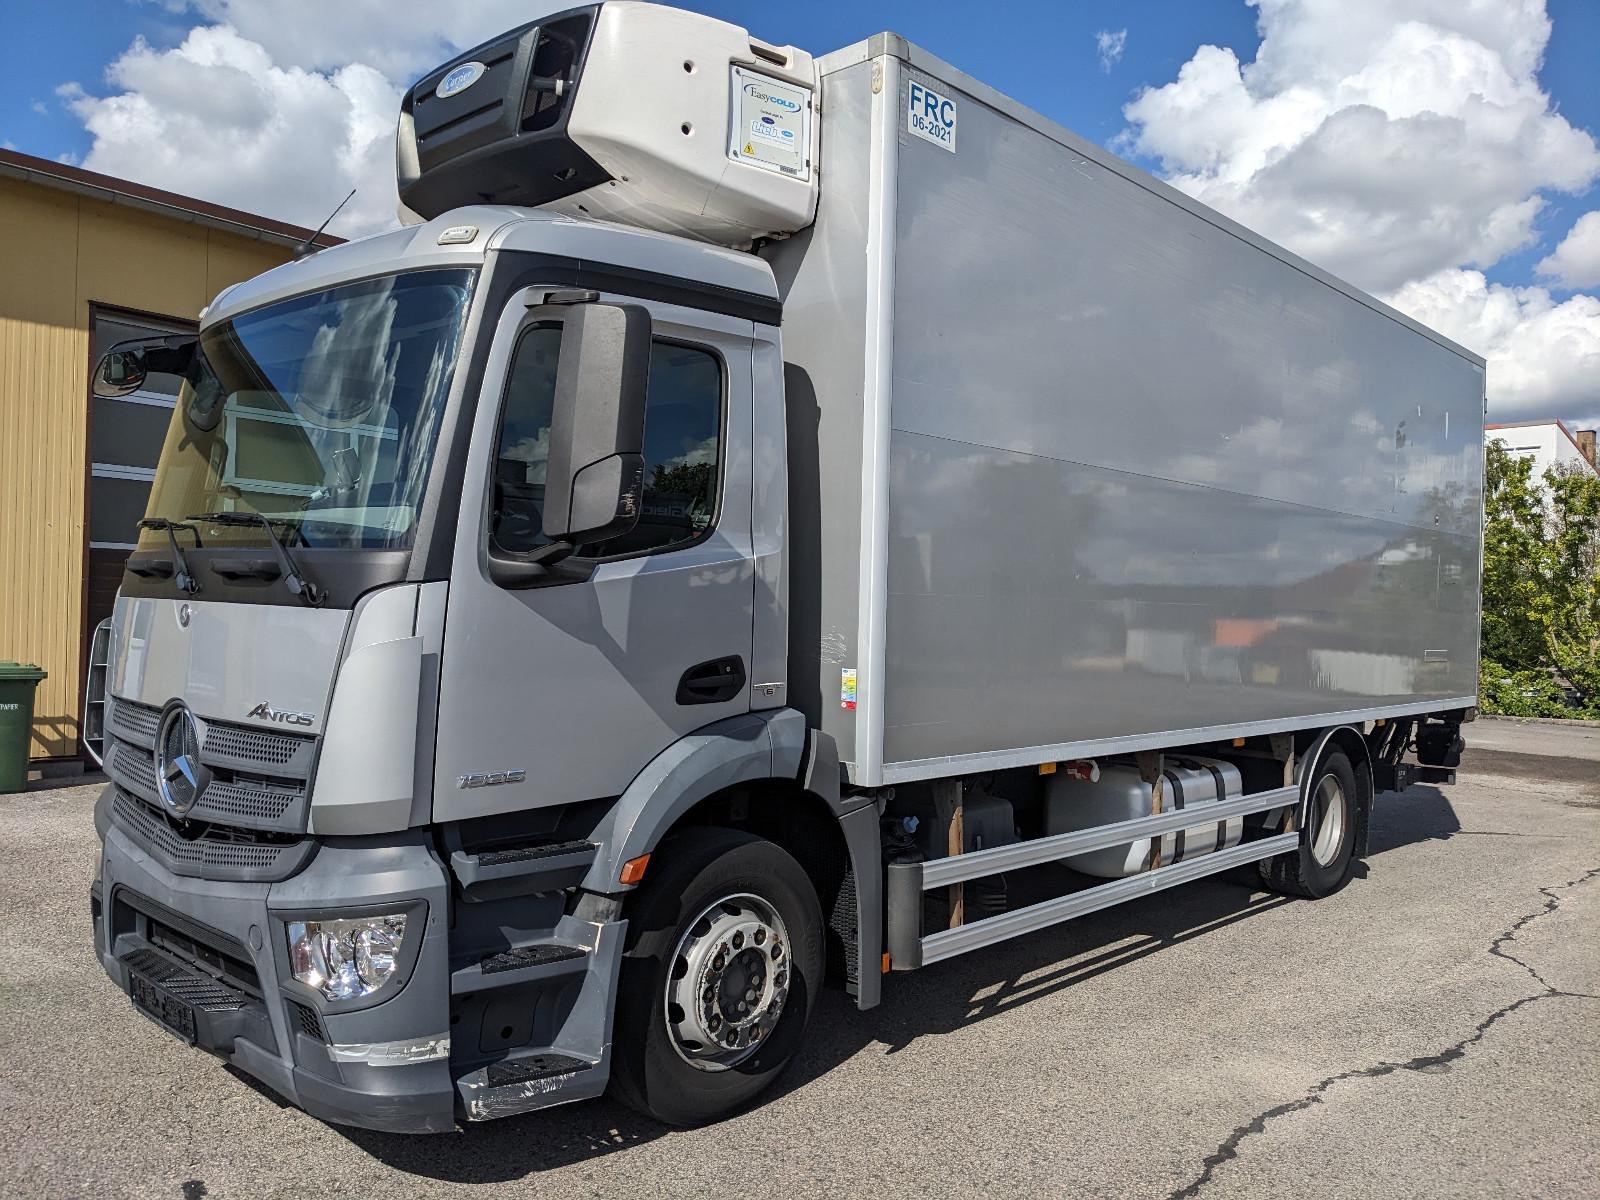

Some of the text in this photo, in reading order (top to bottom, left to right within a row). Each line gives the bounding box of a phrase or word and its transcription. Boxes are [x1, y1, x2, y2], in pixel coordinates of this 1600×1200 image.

[750, 87, 796, 109] EasyCOLD
[911, 84, 954, 128] FRC
[912, 114, 951, 143] 06-2021
